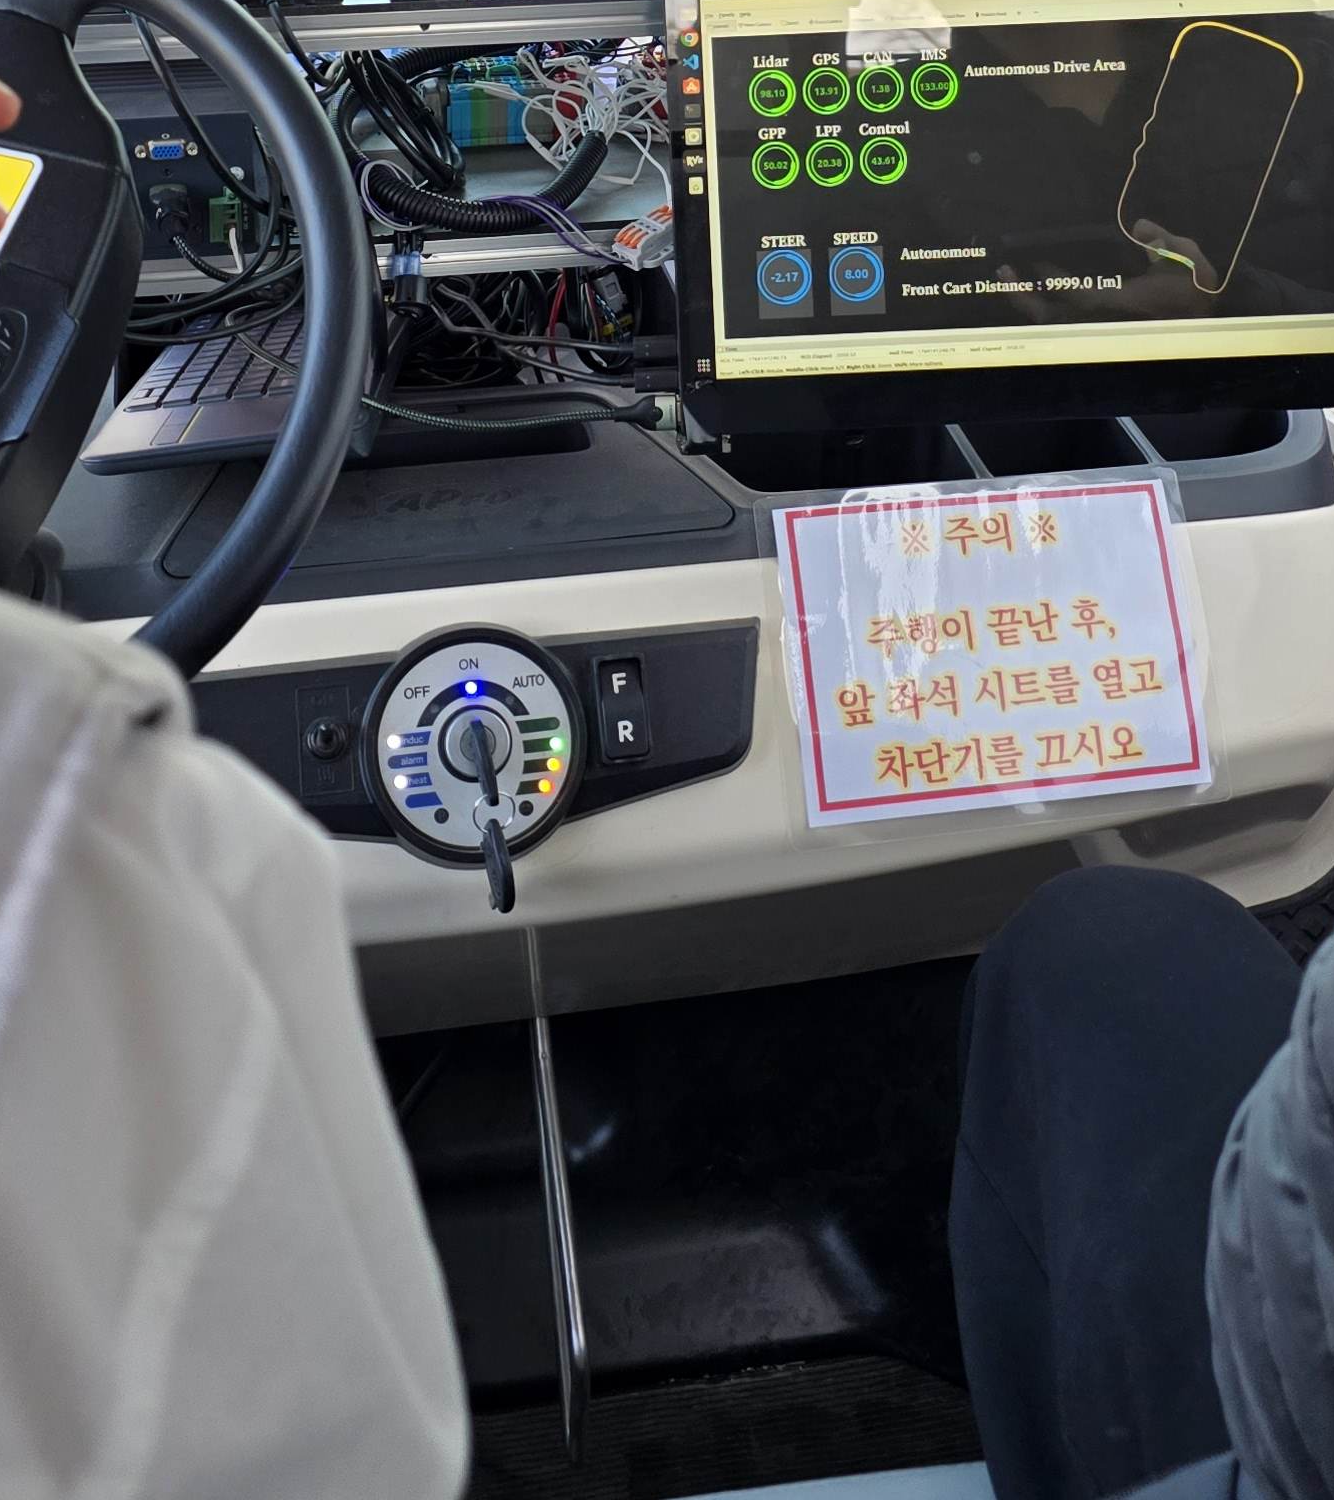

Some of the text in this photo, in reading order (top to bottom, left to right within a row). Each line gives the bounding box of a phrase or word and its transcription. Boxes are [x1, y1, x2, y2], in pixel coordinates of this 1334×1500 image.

[752, 48, 948, 68] Lidar GPS CAN IMS
[964, 57, 1126, 78] Autonomous Drive Area
[757, 121, 910, 140] GPP LPP Control
[760, 231, 879, 249] STEER SPEED
[900, 246, 987, 261] Autonomous
[770, 268, 869, 284] -2.17 8.00
[901, 283, 940, 297] Front
[942, 281, 972, 295] Cart
[975, 278, 1033, 294] Distance
[1045, 276, 1093, 291] 9999.0
[1097, 274, 1122, 291] [m]
[944, 511, 1013, 556] 주의
[867, 599, 1116, 657] 주행이 끝난 후,
[458, 658, 479, 670] ON
[403, 674, 545, 700] OFF AUTO
[612, 673, 627, 694] F
[838, 659, 1163, 727] 앞 좌석 시트를 열고
[619, 721, 634, 742] R
[400, 756, 424, 765] alarm
[877, 726, 1144, 788] 차단기를 끄시오
